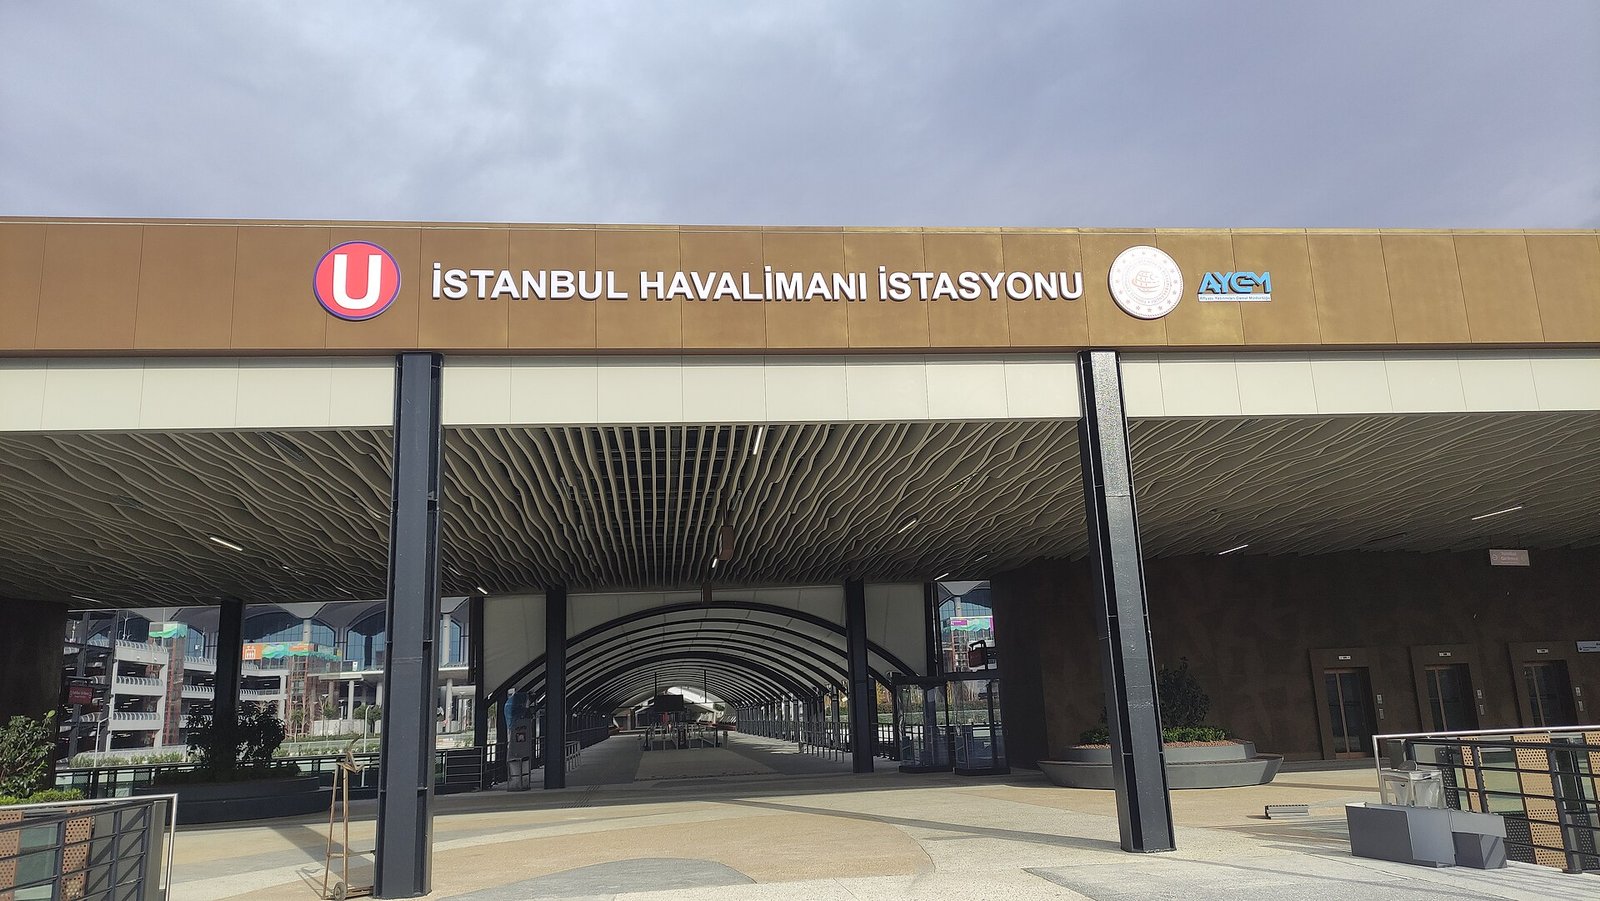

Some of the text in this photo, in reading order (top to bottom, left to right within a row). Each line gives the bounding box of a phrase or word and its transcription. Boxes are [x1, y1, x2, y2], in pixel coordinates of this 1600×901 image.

[333, 254, 382, 310] U
[432, 262, 628, 301] İSTANBUL
[640, 265, 867, 302] HAVALİMANI
[879, 265, 1083, 302] İSTASYONU
[1198, 271, 1272, 293] AYGM
